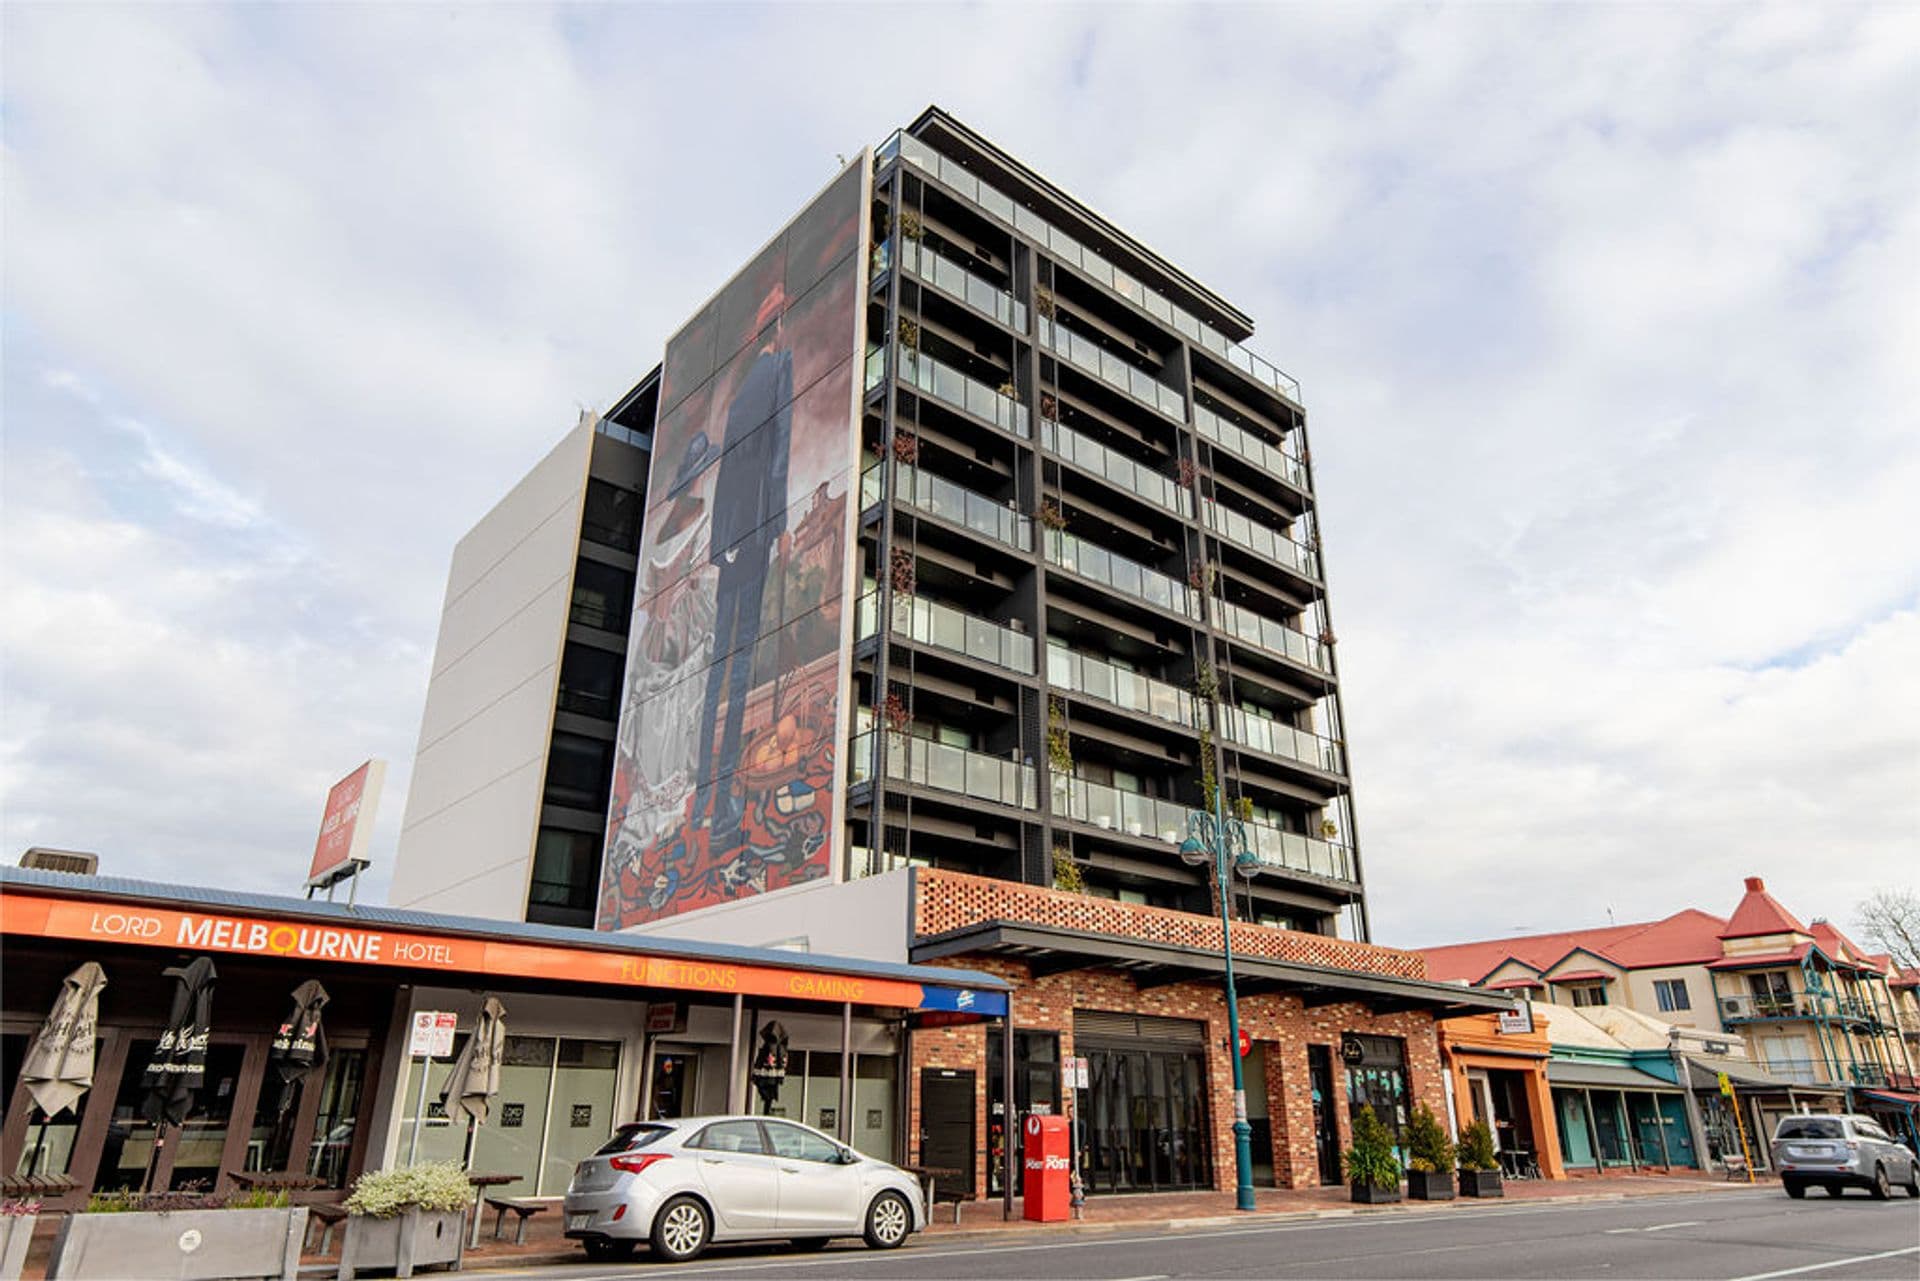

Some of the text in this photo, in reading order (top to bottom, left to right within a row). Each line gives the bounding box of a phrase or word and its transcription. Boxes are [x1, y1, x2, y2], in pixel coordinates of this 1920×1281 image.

[91, 913, 454, 963] LORD MELBOURNE HOTEL
[620, 960, 737, 989] FUNCTIONS
[789, 976, 864, 999] GAMING
[1045, 1158, 1069, 1170] POST
